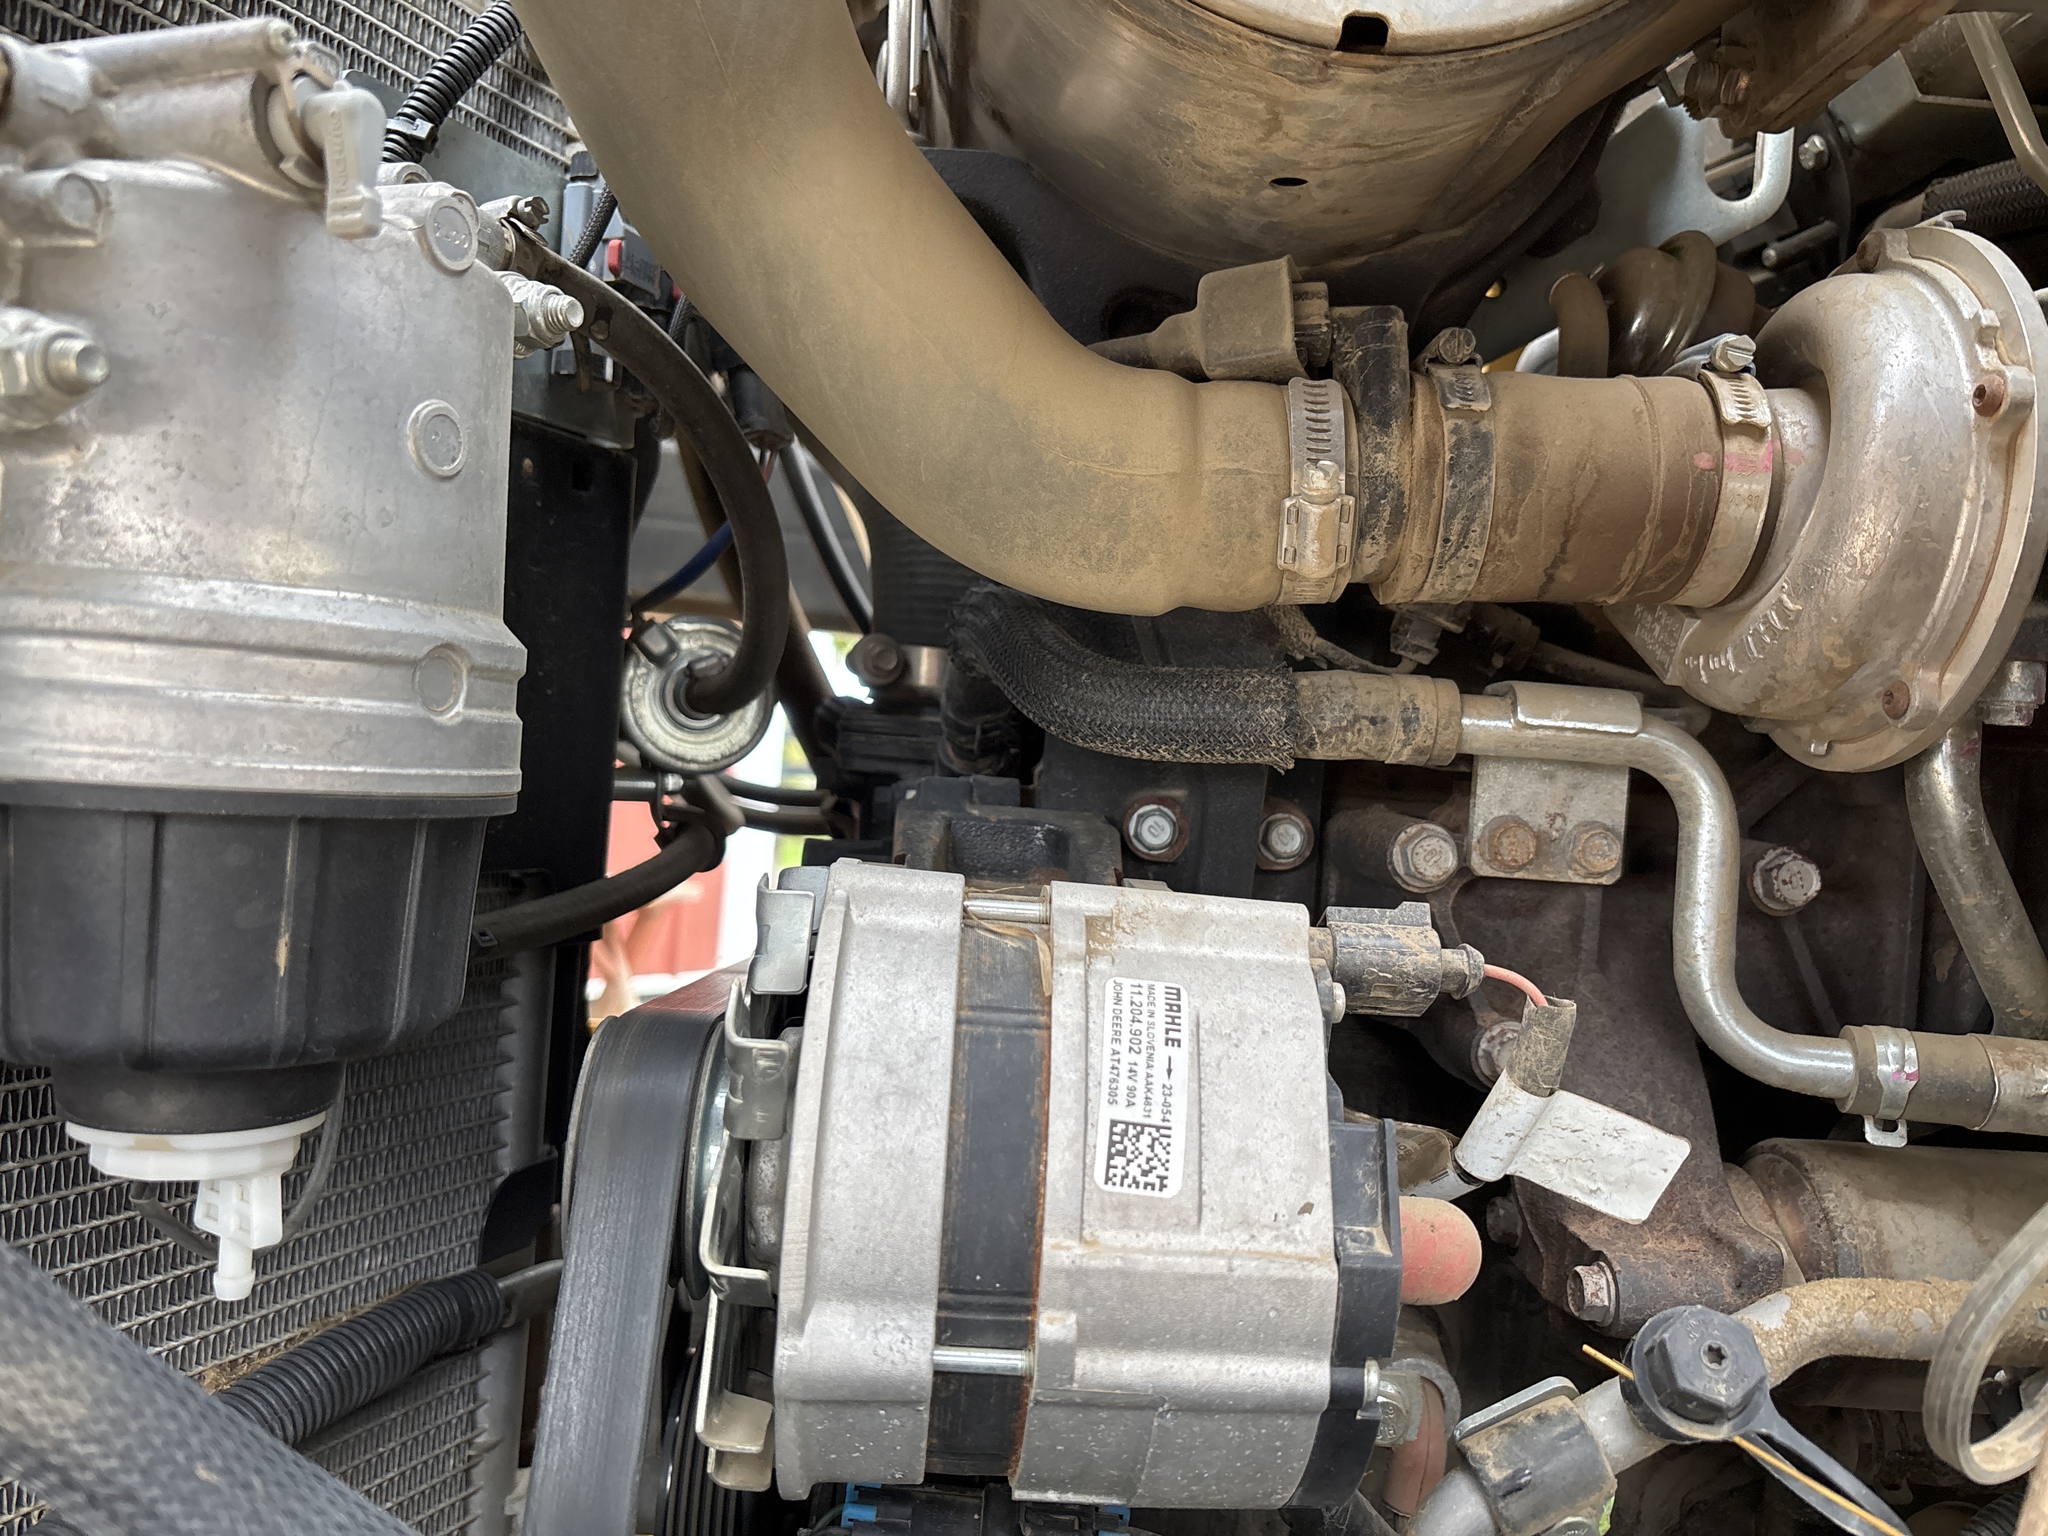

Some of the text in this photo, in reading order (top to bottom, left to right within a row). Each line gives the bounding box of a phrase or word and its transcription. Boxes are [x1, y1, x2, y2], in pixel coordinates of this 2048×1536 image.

[1107, 979, 1123, 1106] JOHN DEERE AT476305
[1125, 982, 1143, 1109] 11.204.902 14V 90A
[1142, 983, 1156, 1119] MADE IN SLOVENIA AAK4631
[1160, 985, 1181, 1123] MAHLE 23-054
